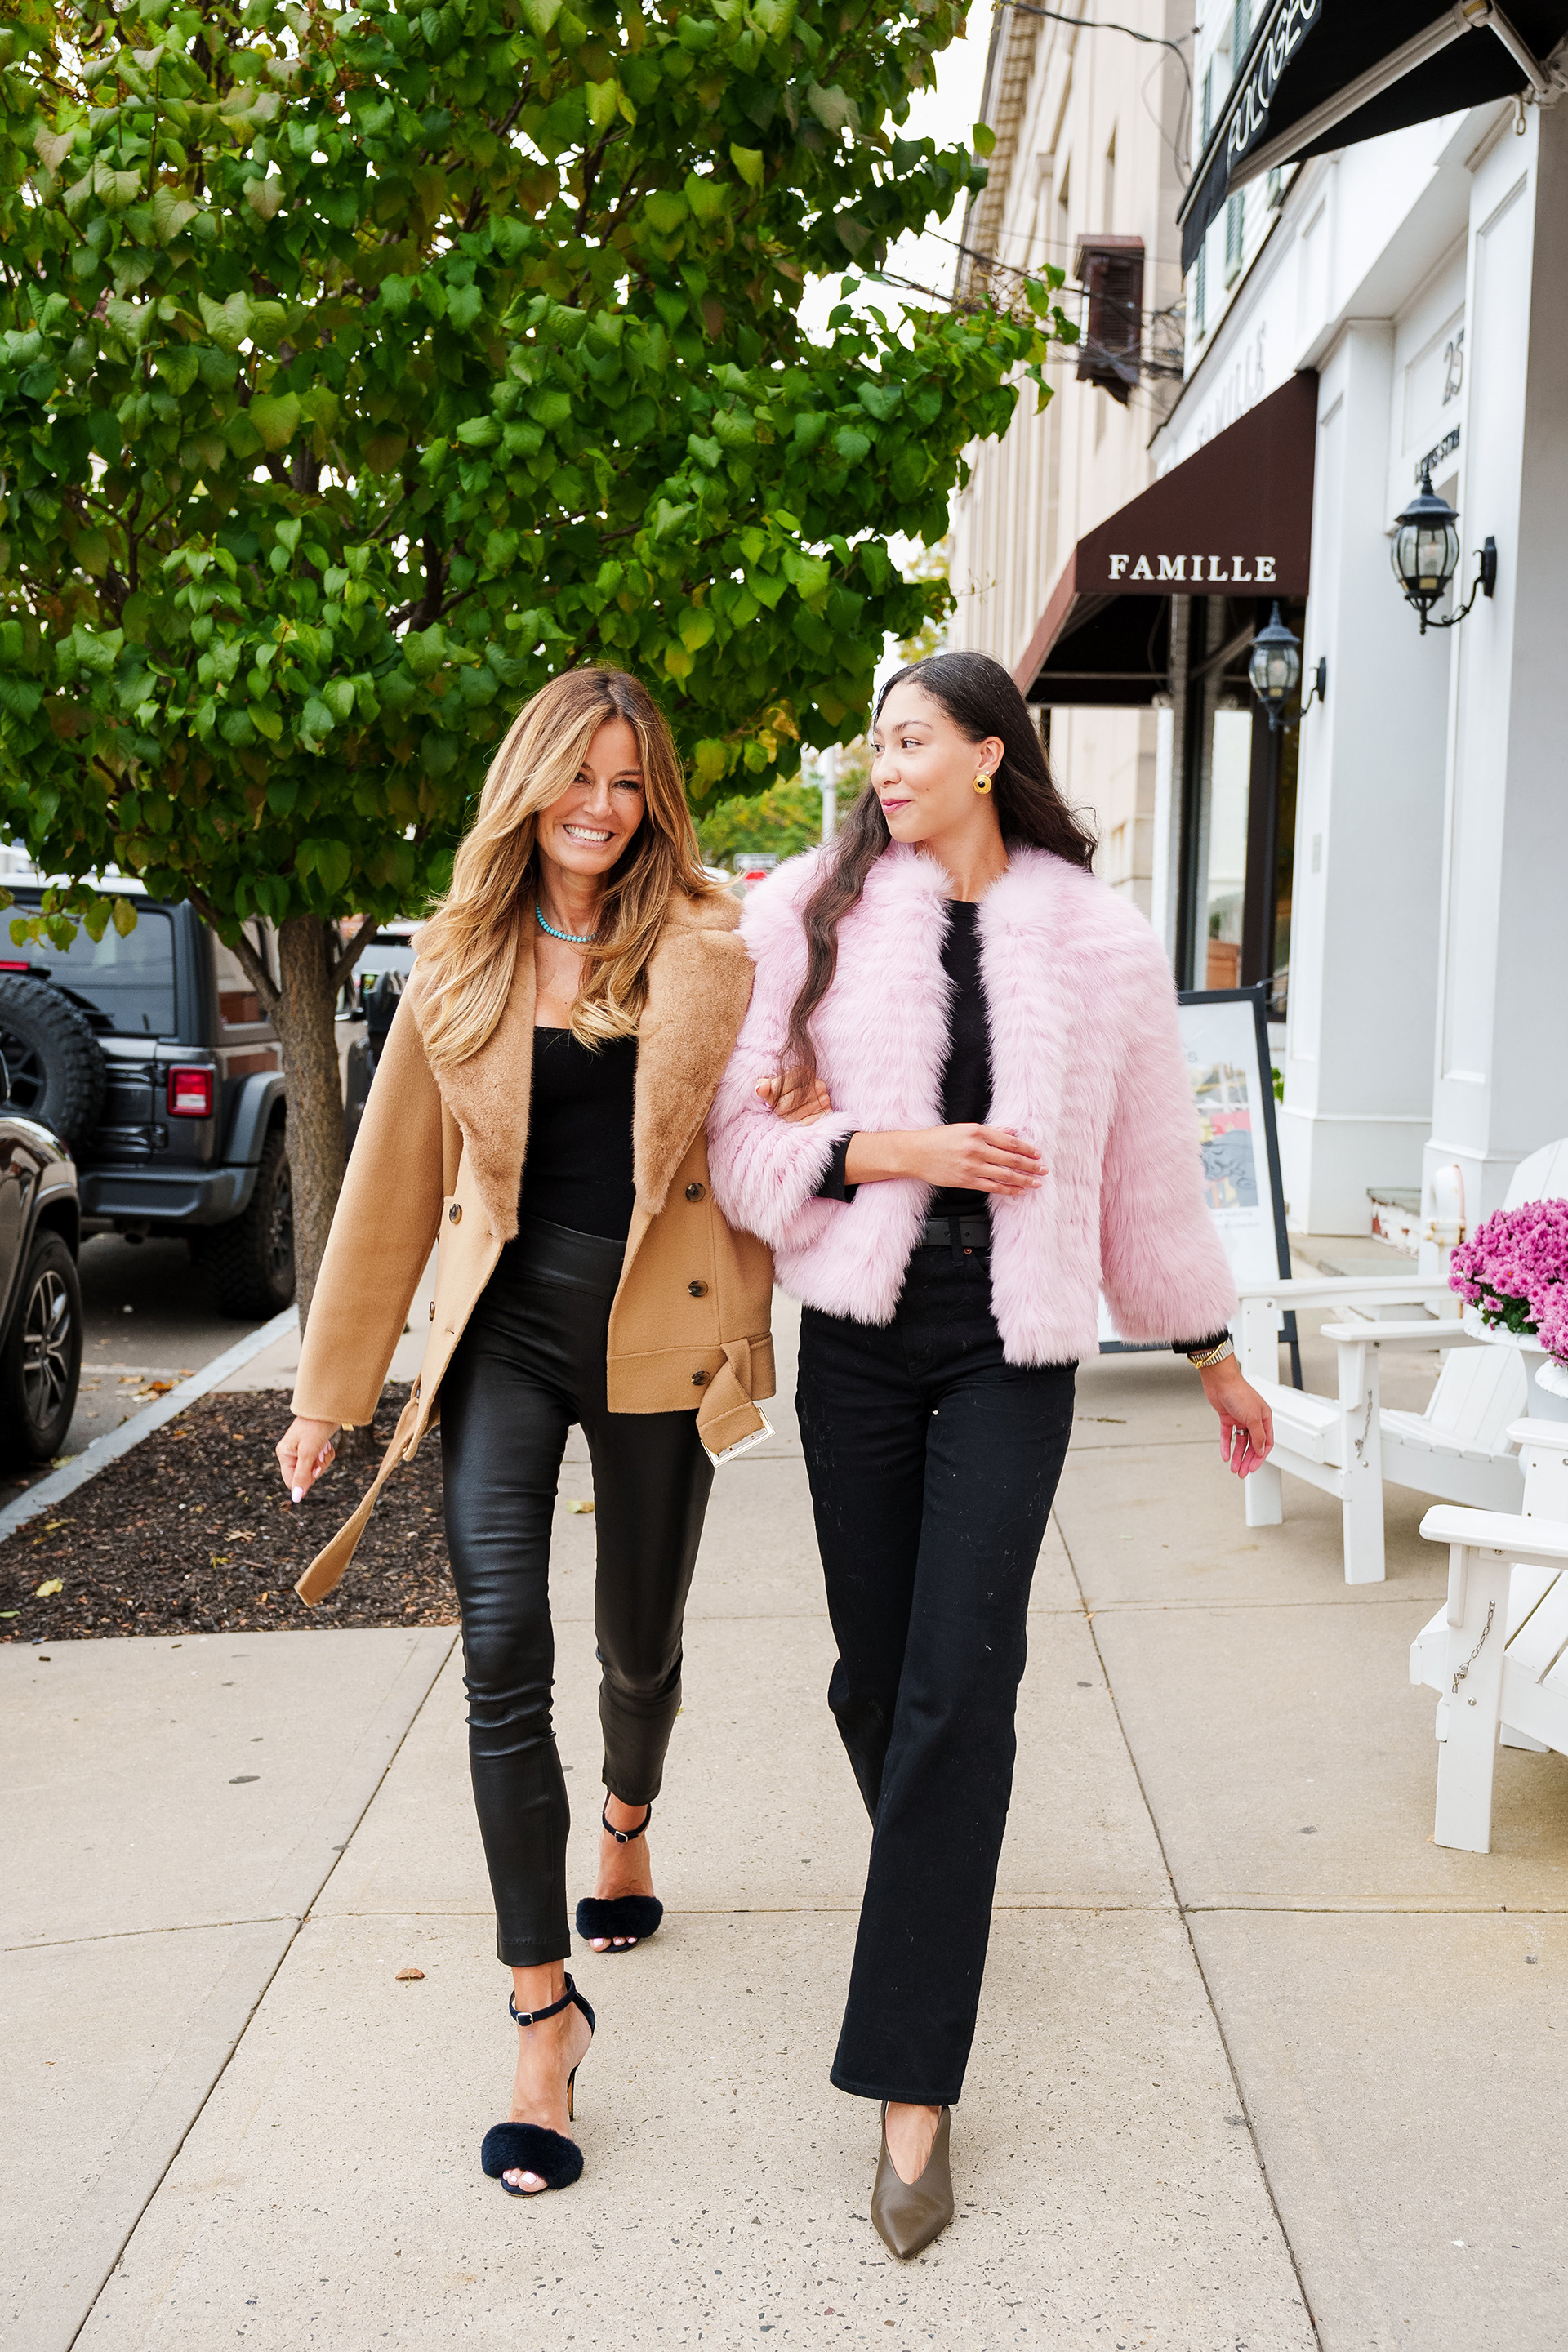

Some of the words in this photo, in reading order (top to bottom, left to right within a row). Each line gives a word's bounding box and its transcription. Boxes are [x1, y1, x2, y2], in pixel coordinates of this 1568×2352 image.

[1226, 0, 1316, 178] POLOGE
[1443, 327, 1464, 406] 25
[1107, 554, 1276, 582] FAMILLE
